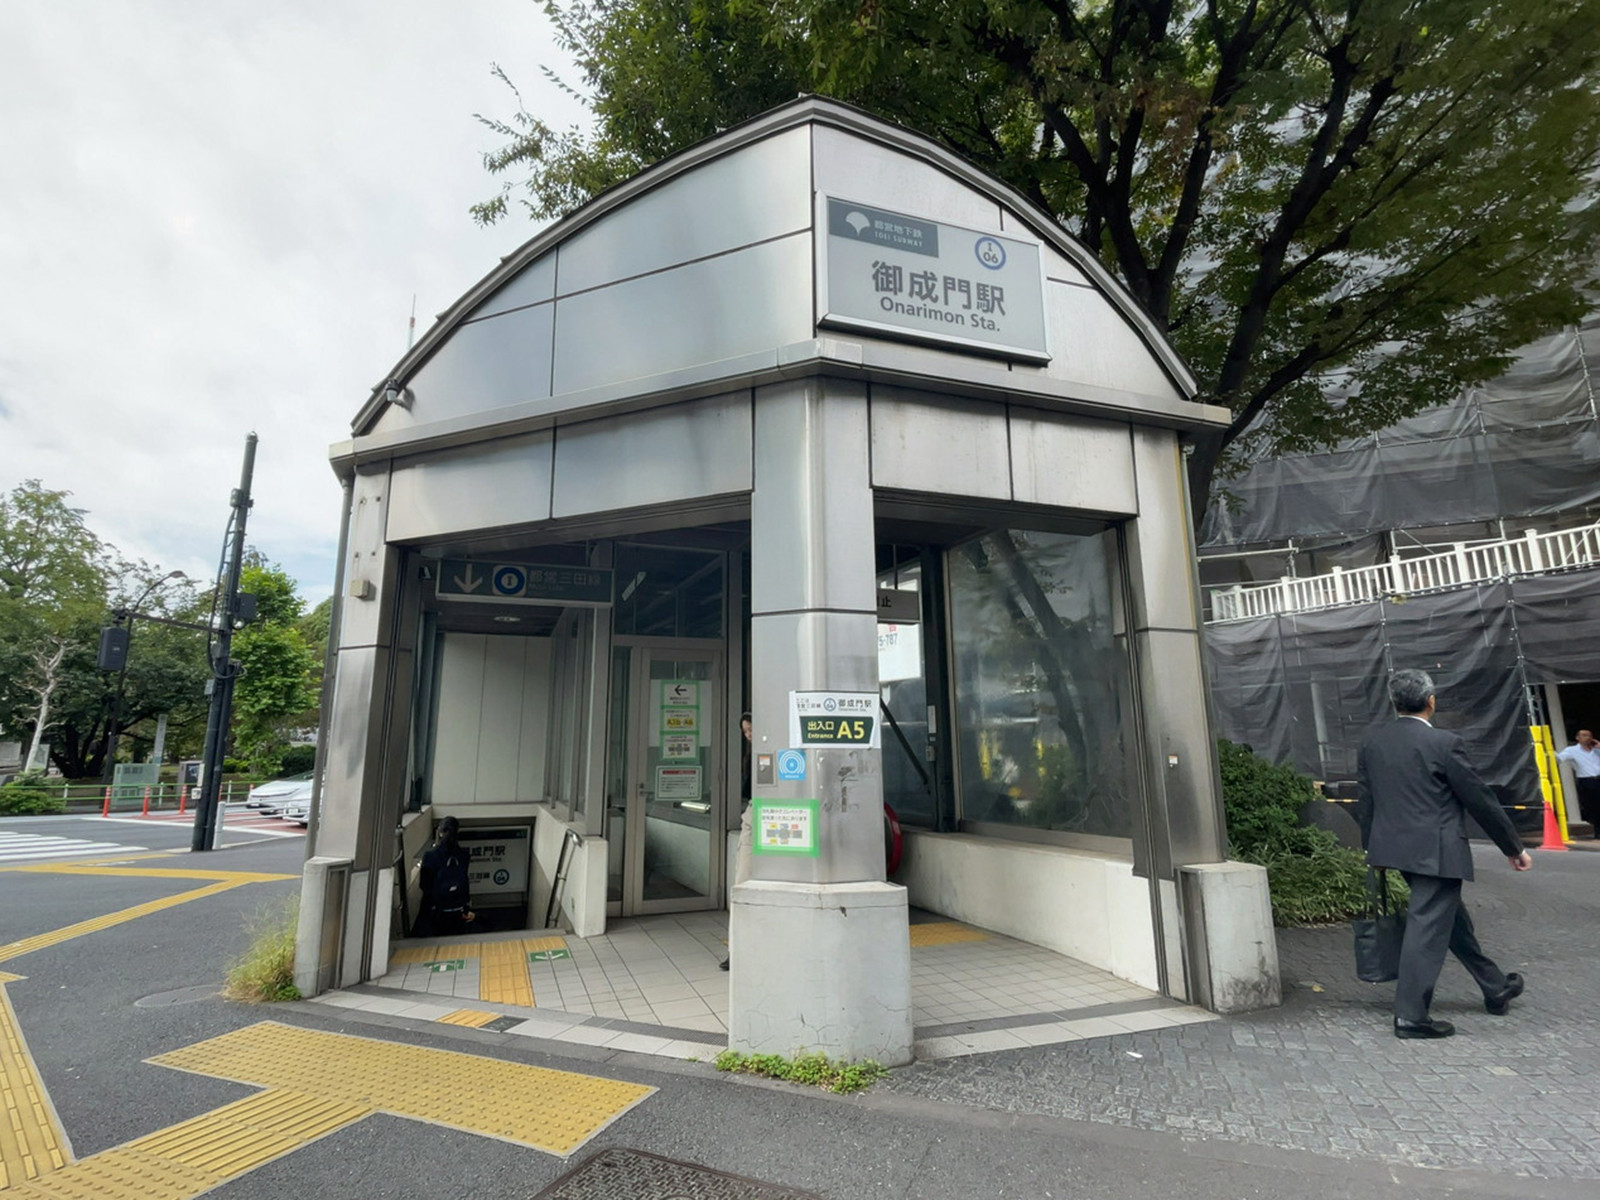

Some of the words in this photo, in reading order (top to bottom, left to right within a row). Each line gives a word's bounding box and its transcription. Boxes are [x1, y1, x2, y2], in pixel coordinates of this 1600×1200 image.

[874, 219, 923, 239] 都営地下鉄
[874, 231, 890, 241] TOEI
[893, 234, 923, 247] SUBWAY
[986, 242, 993, 252] I
[983, 251, 998, 264] 06
[871, 259, 1006, 316] 御成門駅
[880, 296, 965, 326] Onarimon
[970, 313, 1000, 332] Sta.
[838, 699, 872, 707] 御成門駅
[807, 720, 834, 731] 出入口
[837, 720, 865, 740] A5
[464, 845, 506, 857] 成門駅
